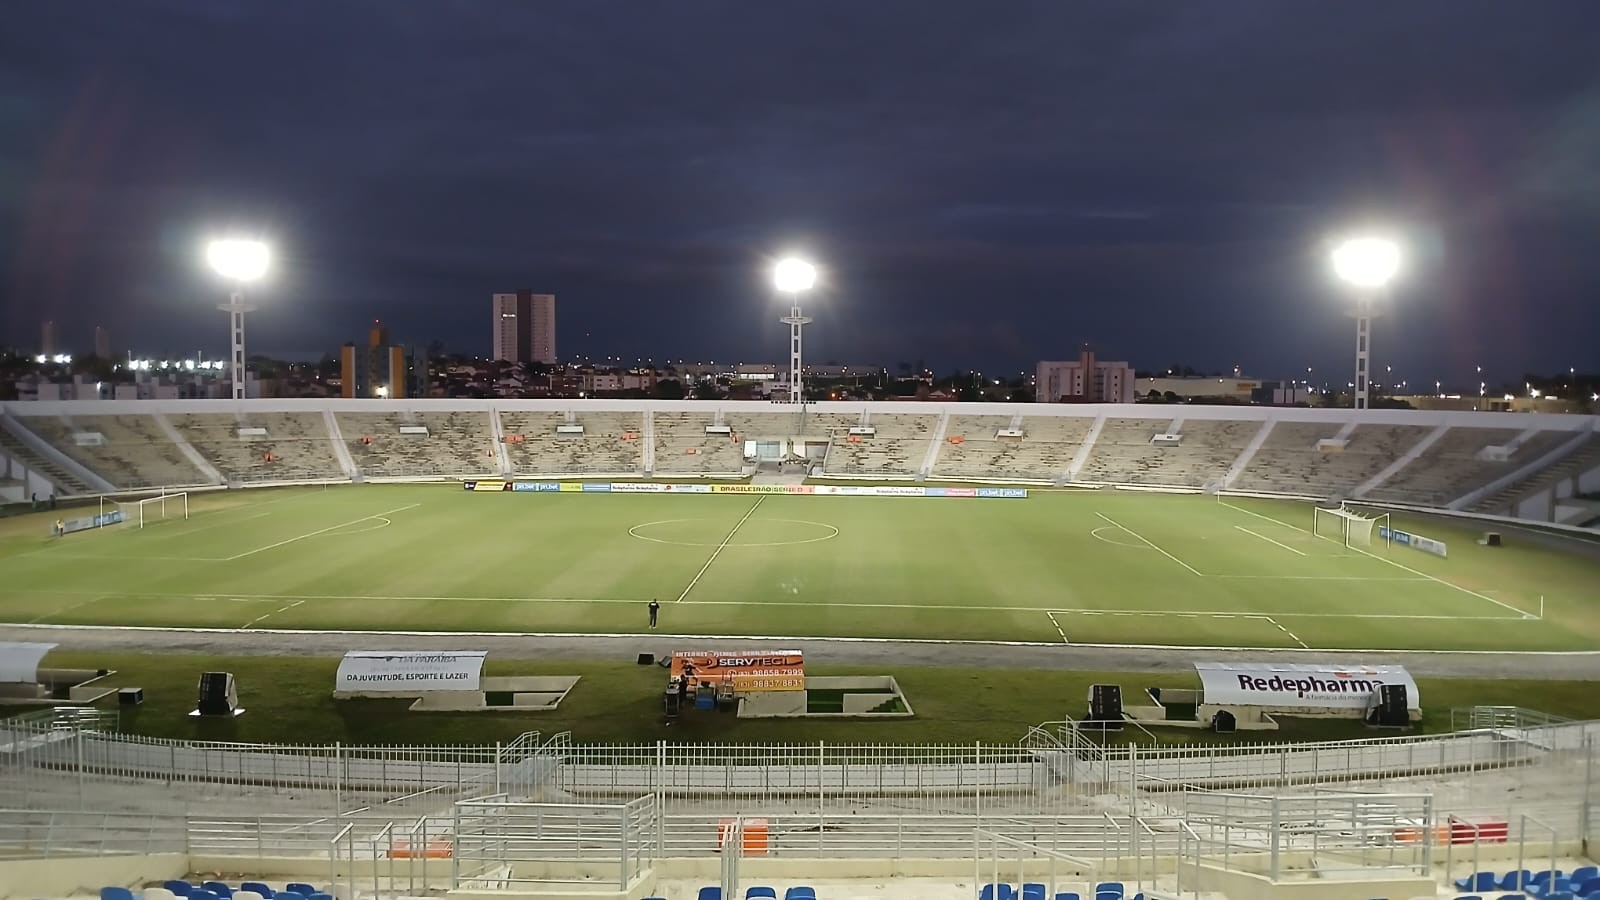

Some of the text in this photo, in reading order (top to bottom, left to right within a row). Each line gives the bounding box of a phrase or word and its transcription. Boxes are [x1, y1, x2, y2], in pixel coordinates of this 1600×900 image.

[359, 673, 405, 682] JUVENTUDE,
[440, 672, 444, 680] E
[446, 672, 469, 680] LAZER
